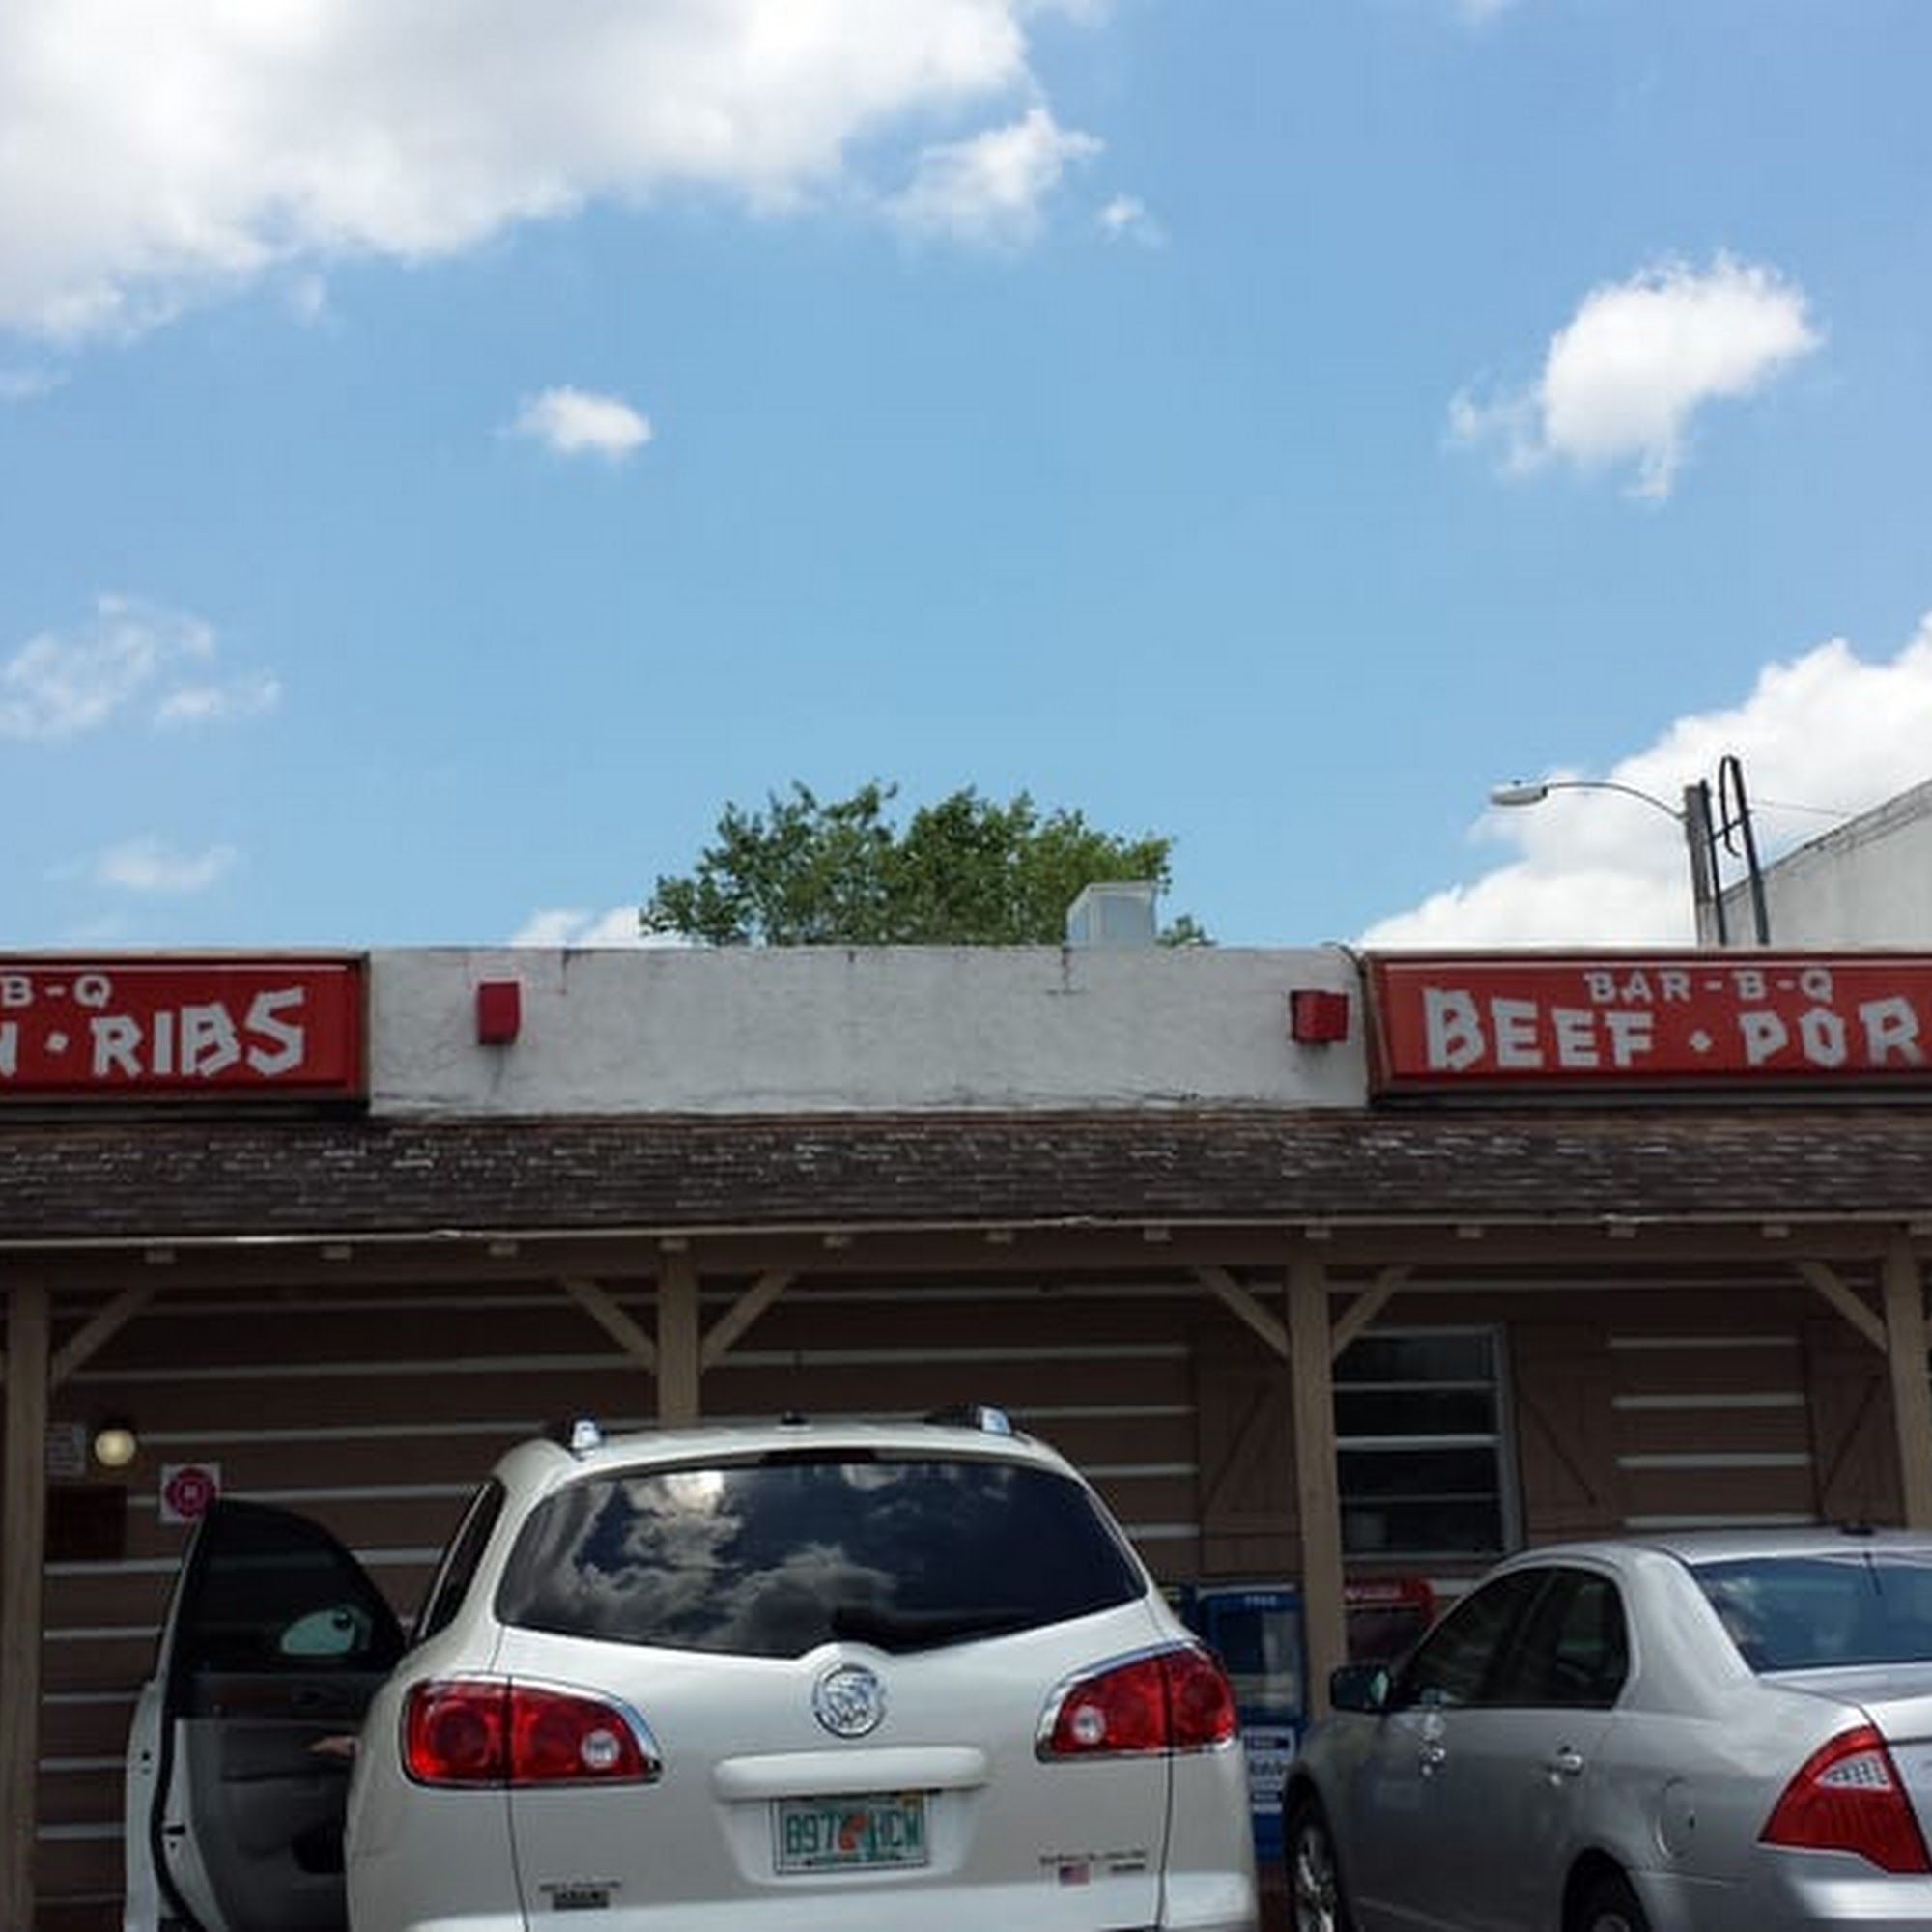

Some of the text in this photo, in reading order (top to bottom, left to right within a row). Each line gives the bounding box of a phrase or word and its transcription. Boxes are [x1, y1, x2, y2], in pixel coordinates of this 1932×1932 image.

[1584, 967, 1833, 1004] BAR-B-Q
[90, 985, 304, 1077] RIBS
[1423, 989, 1925, 1070] BEEF POR
